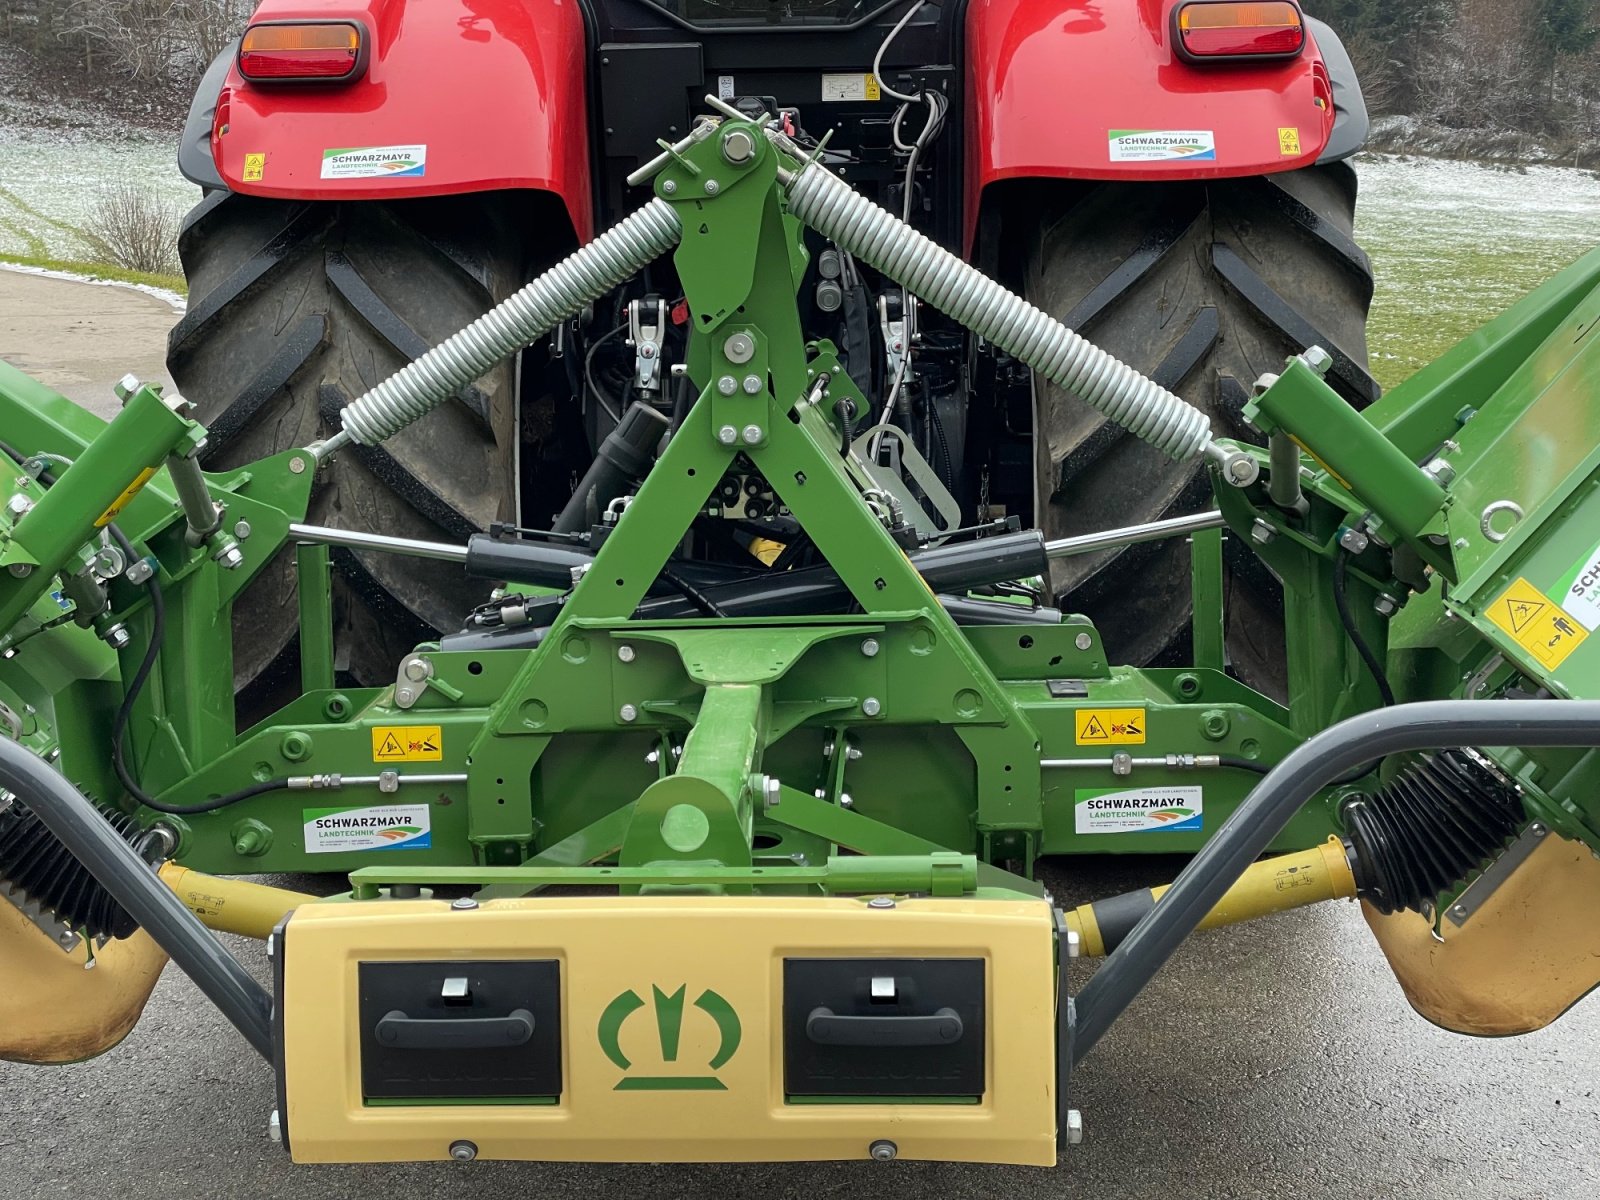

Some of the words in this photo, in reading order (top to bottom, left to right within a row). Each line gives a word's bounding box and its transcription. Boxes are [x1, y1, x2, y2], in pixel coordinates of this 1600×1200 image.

[332, 153, 411, 163] SCHWARZMAYR
[1087, 798, 1185, 809] SCHWARZMAYR
[1089, 811, 1146, 819] LANDTECHNIK
[316, 816, 412, 828] SCHWARZMAYR
[318, 830, 375, 838] LANDTECHNIK
